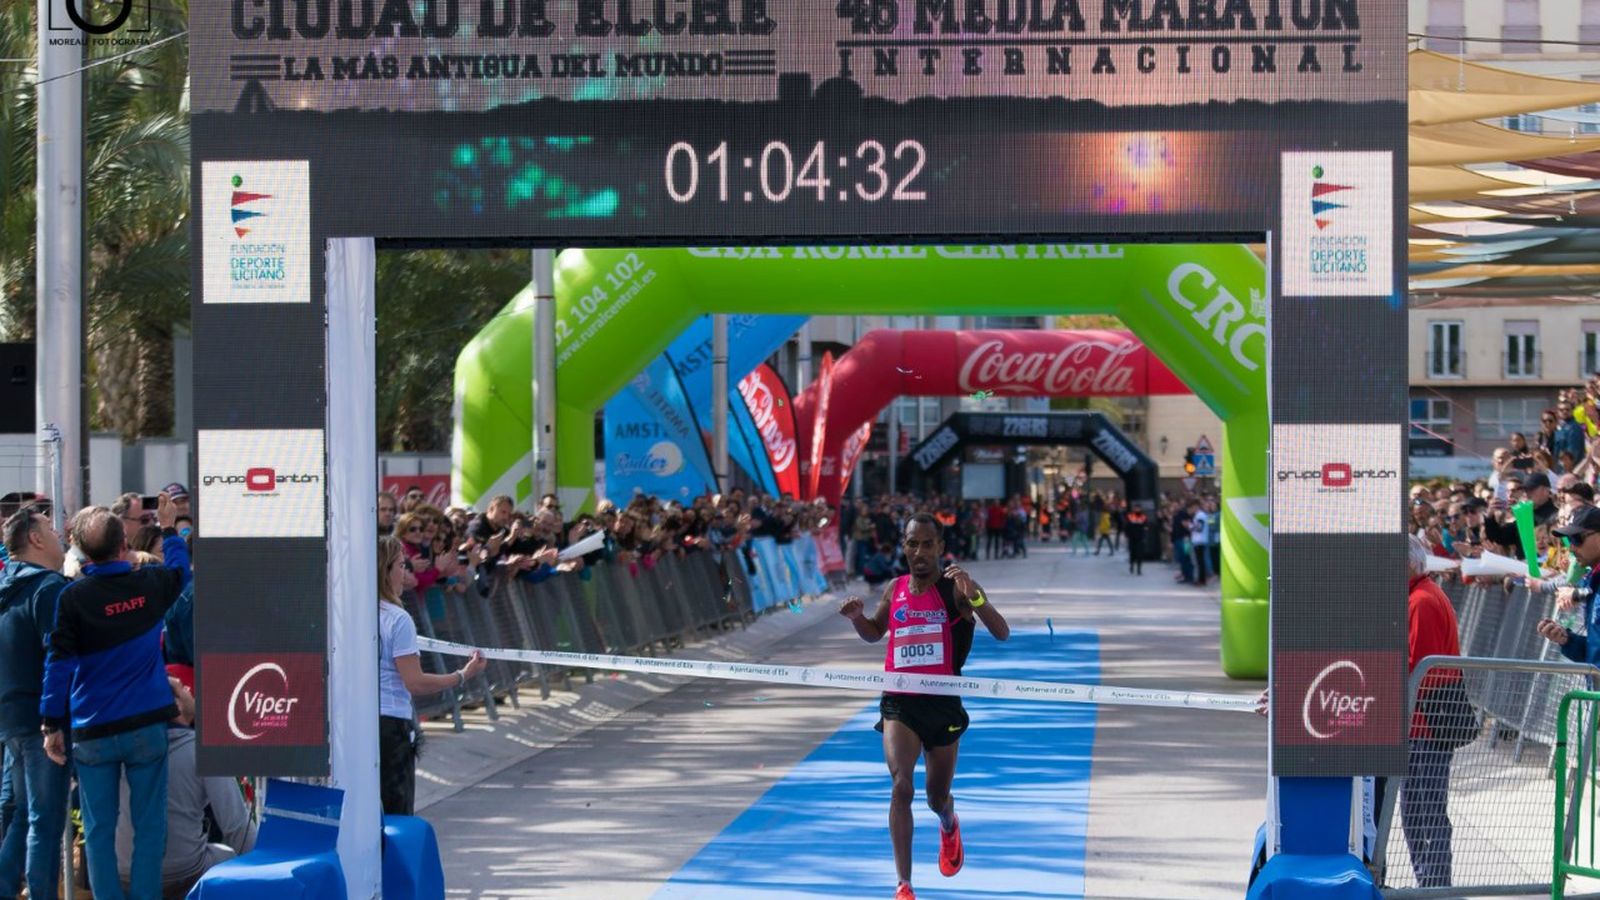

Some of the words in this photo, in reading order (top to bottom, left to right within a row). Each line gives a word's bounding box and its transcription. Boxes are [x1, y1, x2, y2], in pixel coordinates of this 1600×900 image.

[231, 0, 459, 40] CIUDAD
[478, 0, 556, 38] DE
[575, 0, 777, 37] ELCHE
[914, 0, 1085, 34] MEDIA
[284, 57, 325, 80] LA
[332, 51, 399, 80] MÁS
[405, 54, 543, 79] ANTIGUA
[550, 54, 606, 78] DEL
[614, 52, 723, 77] MUNDO
[838, 45, 1363, 76] INTERNACIONAL
[665, 140, 928, 202] 01:04:32
[230, 257, 285, 268] DEPORTE
[1311, 250, 1366, 261] DEPORTE
[571, 285, 608, 324] 104
[606, 252, 645, 290] 102
[1167, 262, 1267, 372] CRC
[958, 339, 1143, 394] Coca-Cola
[203, 474, 247, 487] grupo
[1277, 470, 1321, 482] grupo
[104, 596, 145, 617] STAFF
[901, 643, 934, 658] 0003
[824, 672, 866, 682] Ajuntament
[244, 691, 298, 719] Viper
[1320, 690, 1376, 717] Viper
